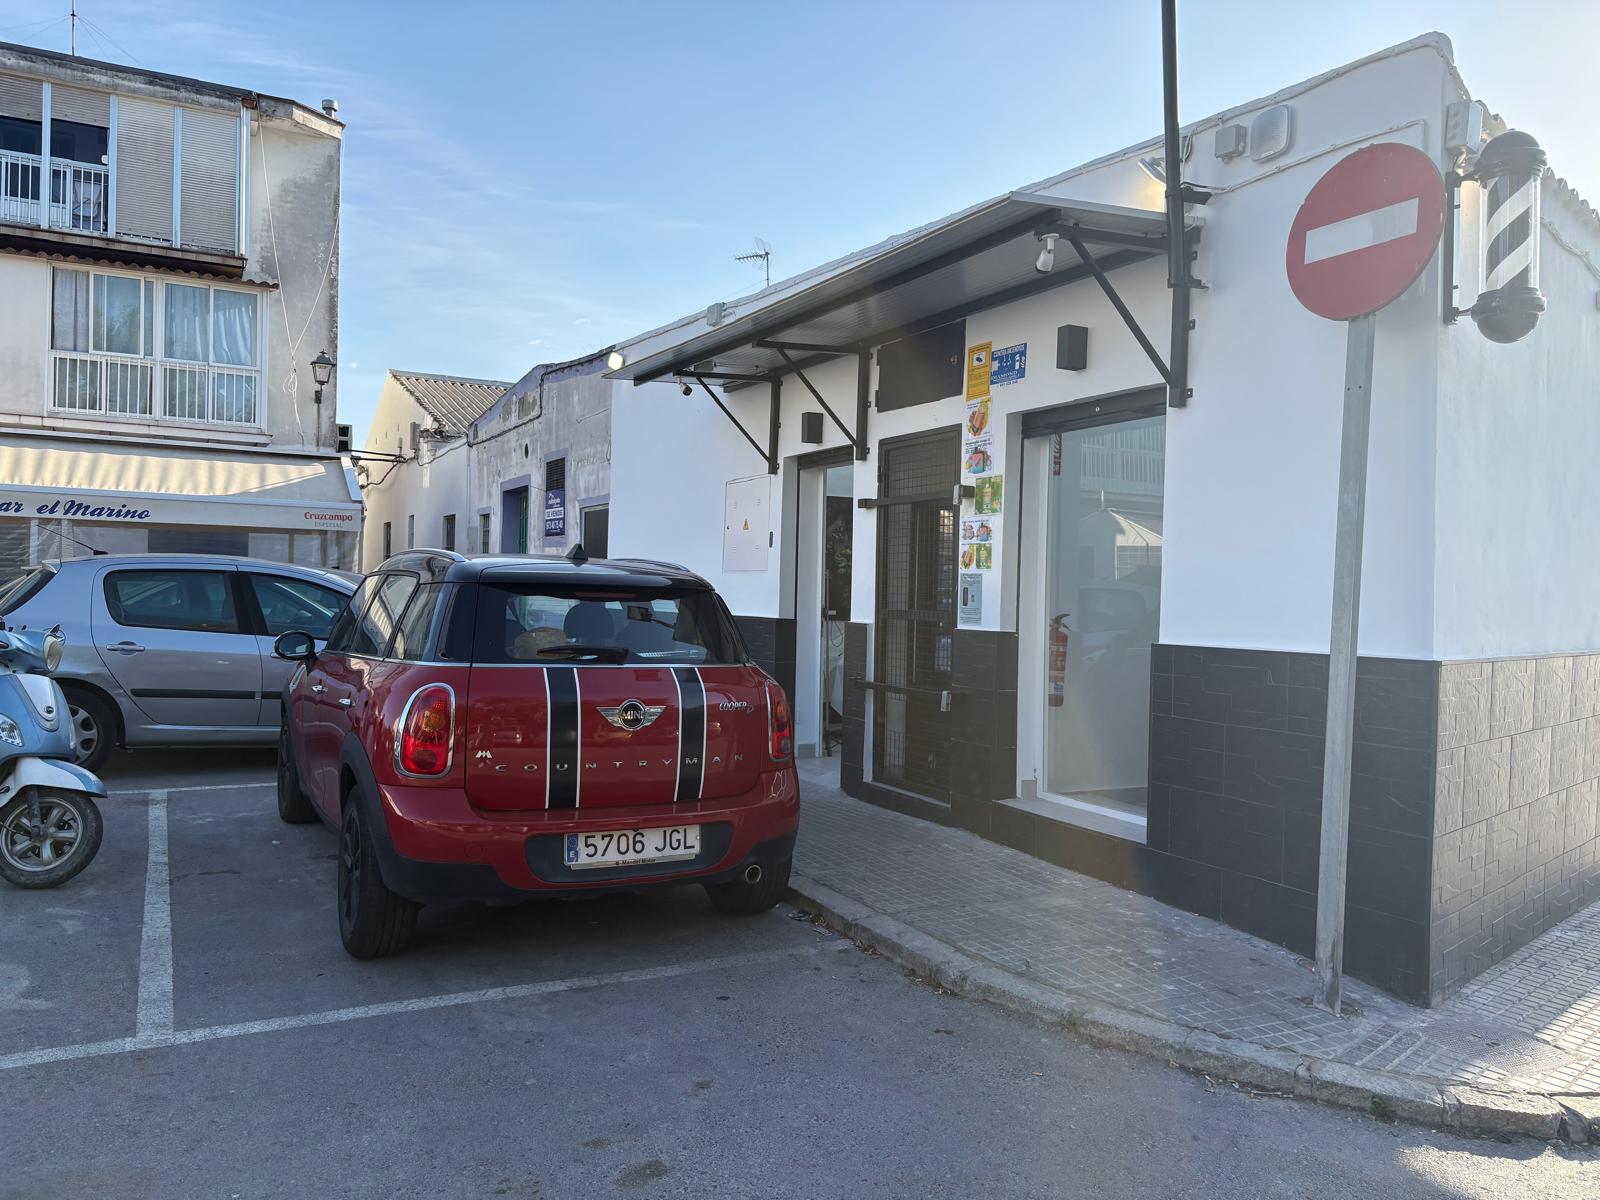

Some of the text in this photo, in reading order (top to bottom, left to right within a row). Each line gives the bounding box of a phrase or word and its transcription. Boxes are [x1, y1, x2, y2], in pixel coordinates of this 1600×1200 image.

[0, 500, 150, 519] ar el Marino
[304, 511, 352, 522] Cruzcampo
[719, 701, 747, 711] COOPER
[622, 710, 644, 719] MINI
[495, 754, 743, 772] COUNTRYMAN
[584, 828, 695, 858] 5706 JGL
